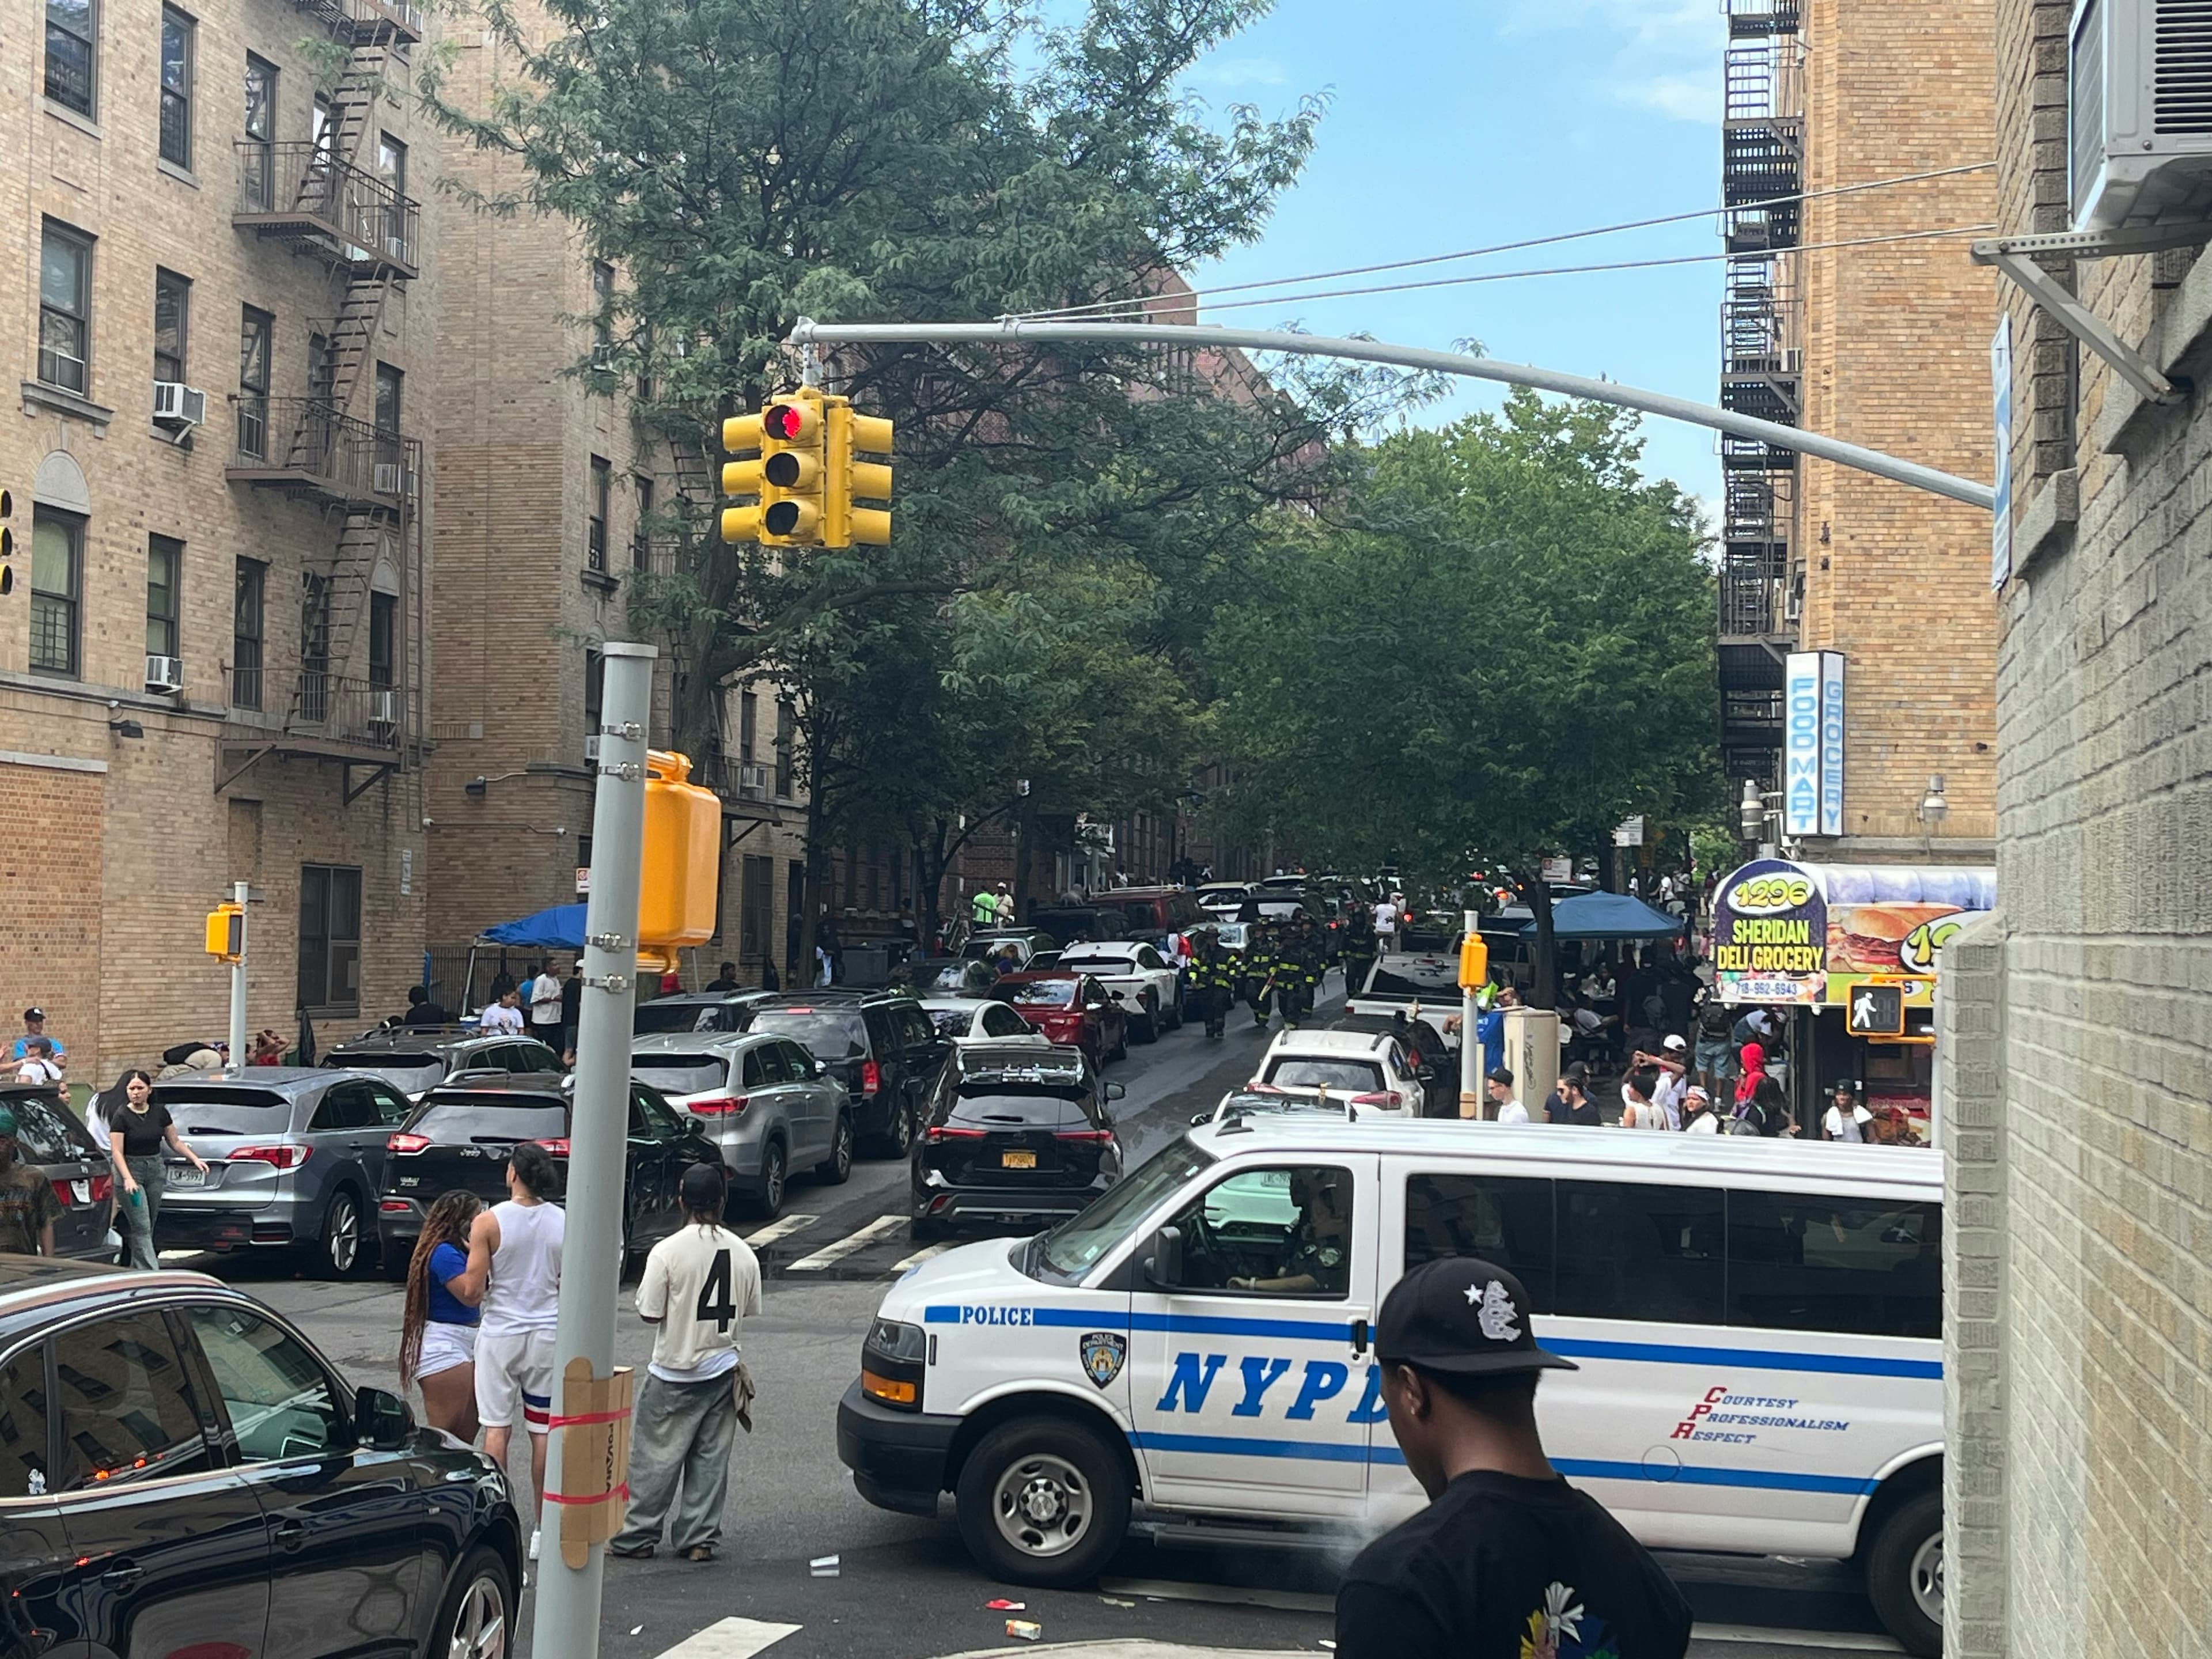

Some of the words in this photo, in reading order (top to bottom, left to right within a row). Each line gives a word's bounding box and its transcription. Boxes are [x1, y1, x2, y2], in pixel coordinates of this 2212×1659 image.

[1791, 677, 1816, 749] FOOD
[1824, 680, 1842, 827] GROCERY
[1791, 756, 1816, 829] MART
[1734, 878, 1808, 908] 1296
[1732, 919, 1810, 945] SHERIDAN
[1717, 945, 1749, 971] DELI
[1751, 945, 1824, 974] GROCERY
[696, 1248, 737, 1334] 4
[962, 1305, 1031, 1326] POLICE
[1704, 1386, 1798, 1409] COURTESY
[1687, 1404, 1850, 1431] PROFESSIONALISM
[1670, 1422, 1756, 1444] RESPECT
